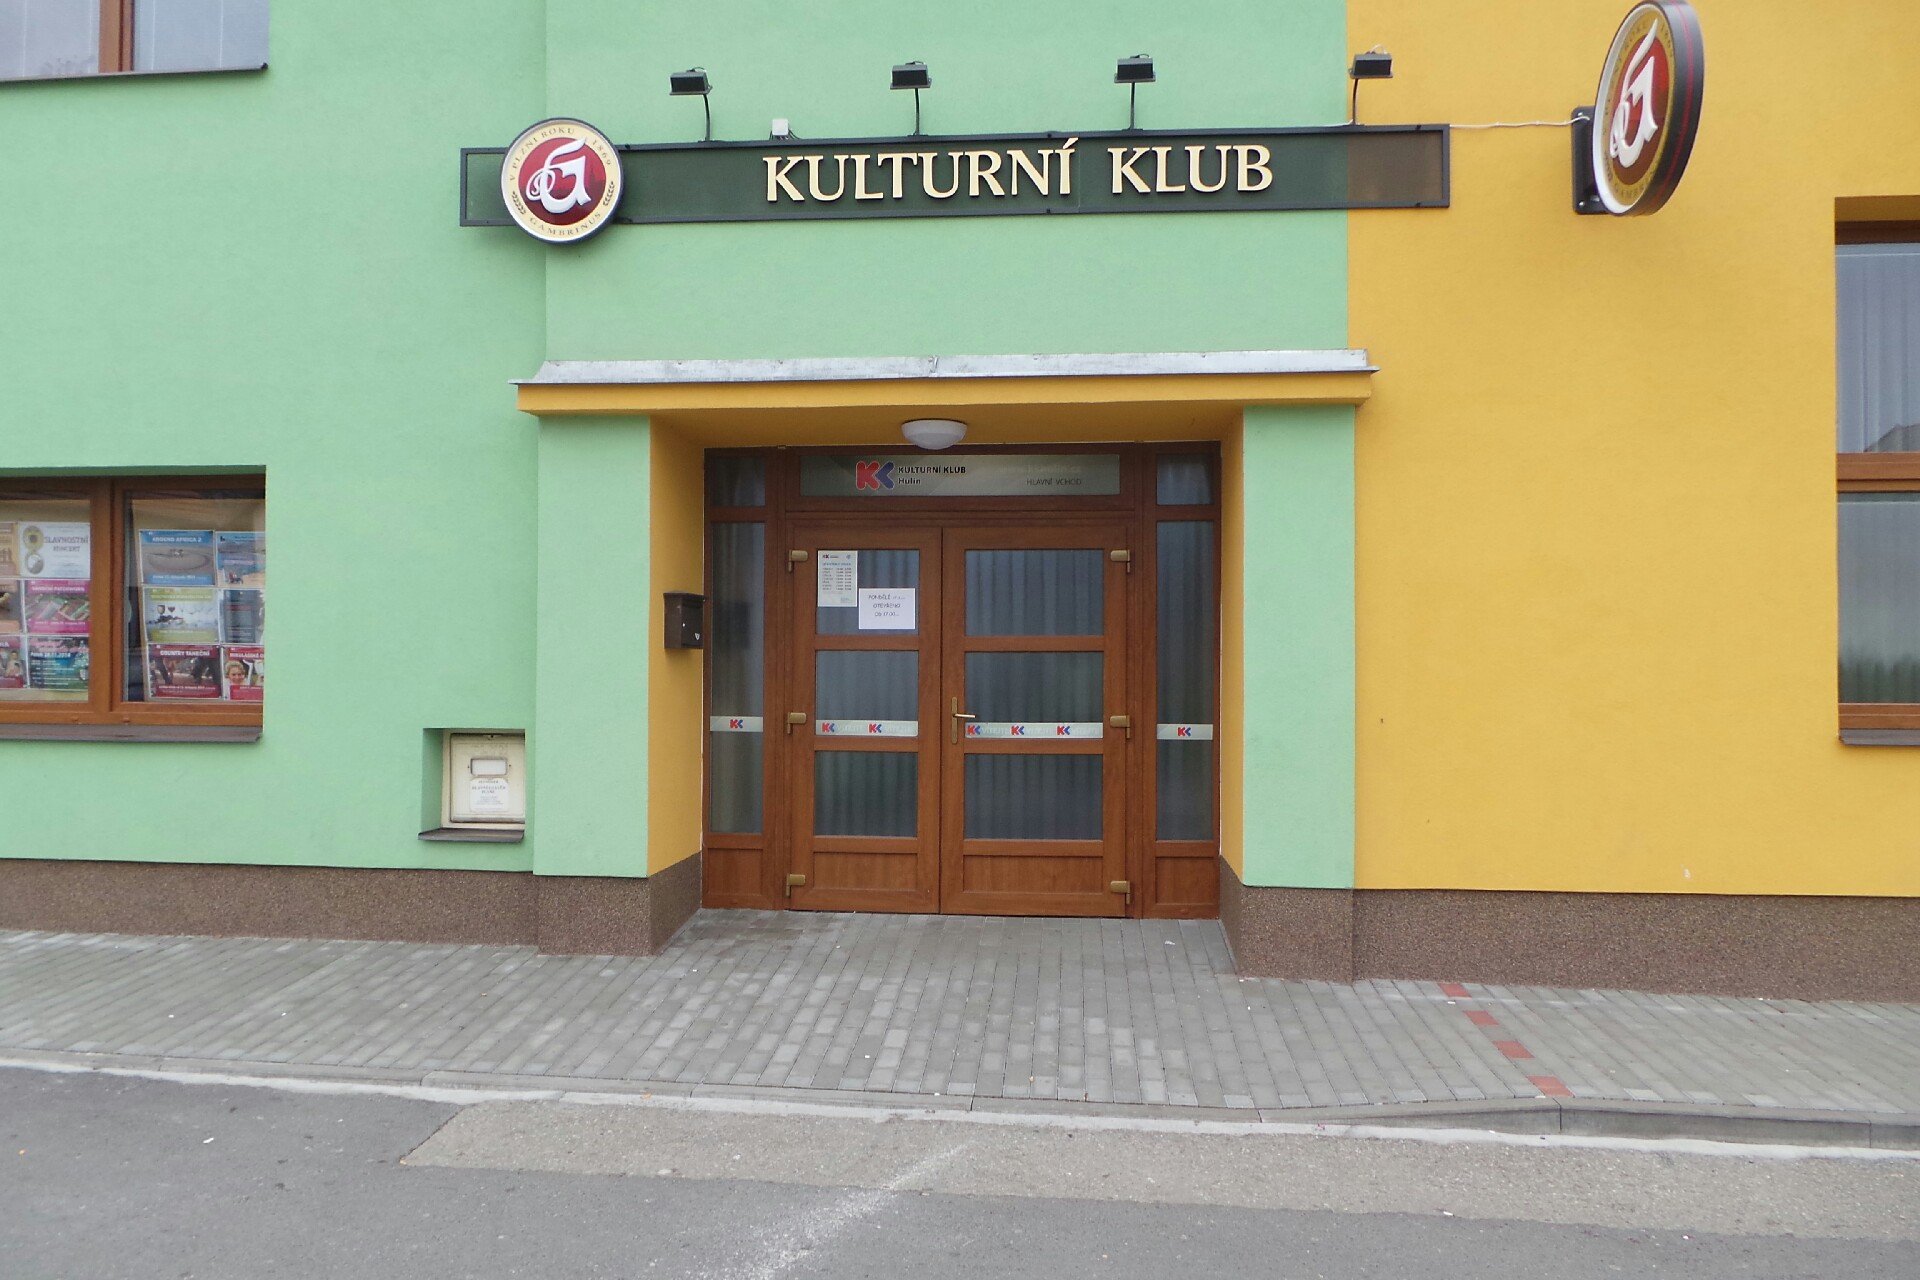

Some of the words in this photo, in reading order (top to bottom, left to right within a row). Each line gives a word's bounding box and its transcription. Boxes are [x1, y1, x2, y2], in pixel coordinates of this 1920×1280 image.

[541, 127, 576, 138] ROKU
[591, 139, 613, 166] 1869
[762, 137, 1080, 202] KULTURNÍ
[1108, 144, 1275, 193] KLUB
[530, 212, 602, 236] GAMBRINUS
[898, 464, 942, 475] KULTURNÍ
[943, 465, 967, 475] KLUB
[1055, 478, 1082, 486] VCHOD
